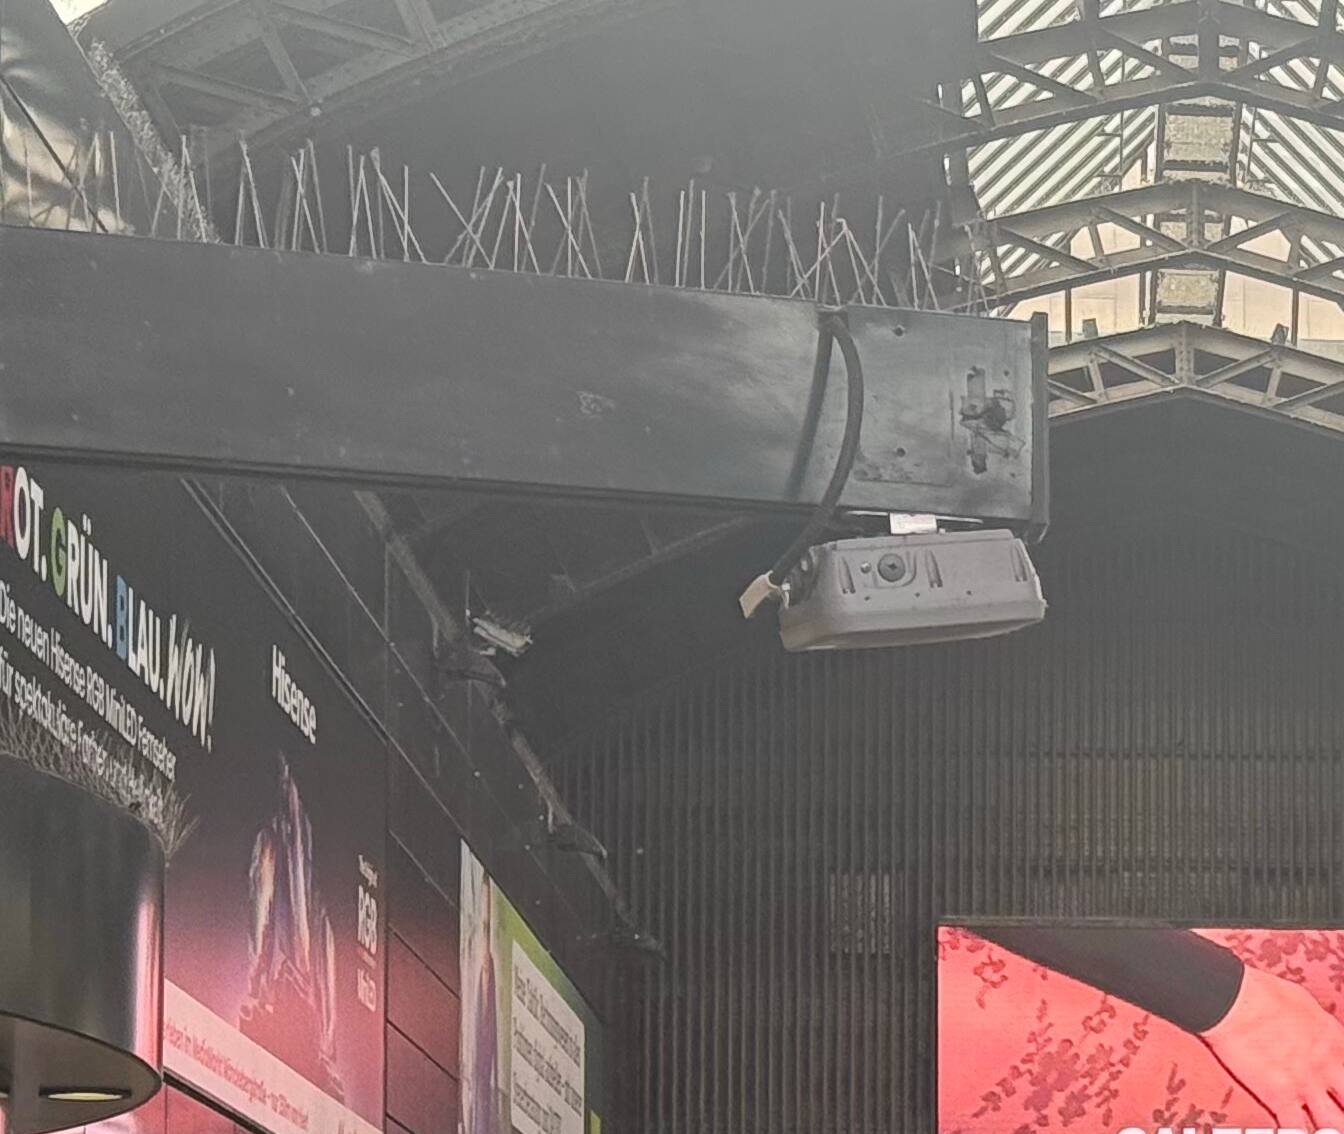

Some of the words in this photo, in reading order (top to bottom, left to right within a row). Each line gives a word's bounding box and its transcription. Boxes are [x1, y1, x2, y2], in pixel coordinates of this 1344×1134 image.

[0, 464, 48, 582] ROT.
[51, 505, 113, 650] GRÜN.
[116, 574, 165, 701] BLAU.
[17, 605, 50, 667] neuen
[51, 627, 86, 699] Hisense
[87, 665, 105, 717] RGB
[272, 643, 317, 745] Hisense
